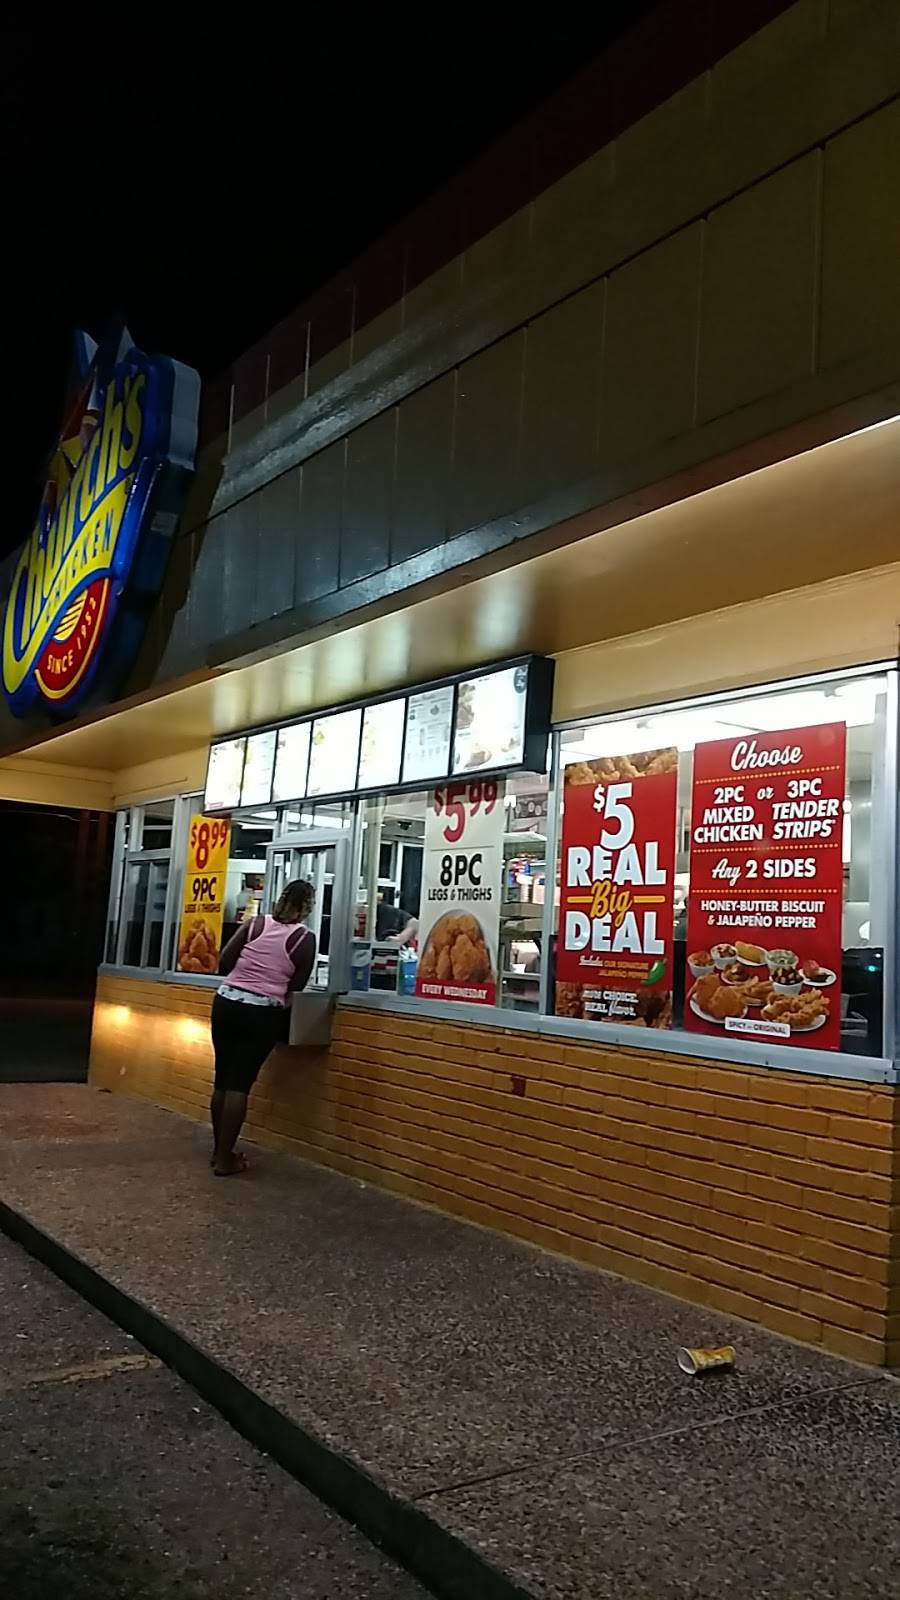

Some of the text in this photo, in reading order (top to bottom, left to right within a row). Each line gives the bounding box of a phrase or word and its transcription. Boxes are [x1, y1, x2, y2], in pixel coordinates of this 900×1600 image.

[47, 649, 74, 675] SINCE
[731, 740, 803, 771] Choose
[714, 778, 821, 804] 2PC or 3PC
[593, 782, 634, 850] $5
[703, 799, 839, 824] MIXED TENDER
[694, 824, 763, 843] CHICKEN
[440, 853, 483, 886] 8PC
[567, 842, 667, 887] REAL
[712, 858, 816, 886] Any 2 SIDES
[192, 876, 217, 902] 9PC
[428, 889, 448, 901] LEGS
[457, 887, 492, 901] THIGHS
[590, 879, 633, 928] Big
[701, 900, 825, 913] HONEY-BUTTER BISCUIT
[565, 911, 665, 955] DEAL
[707, 913, 816, 928] & JALAPEÑO PEPPER
[729, 1021, 746, 1029] SPICY
[753, 1023, 786, 1034] ORIGINAL
